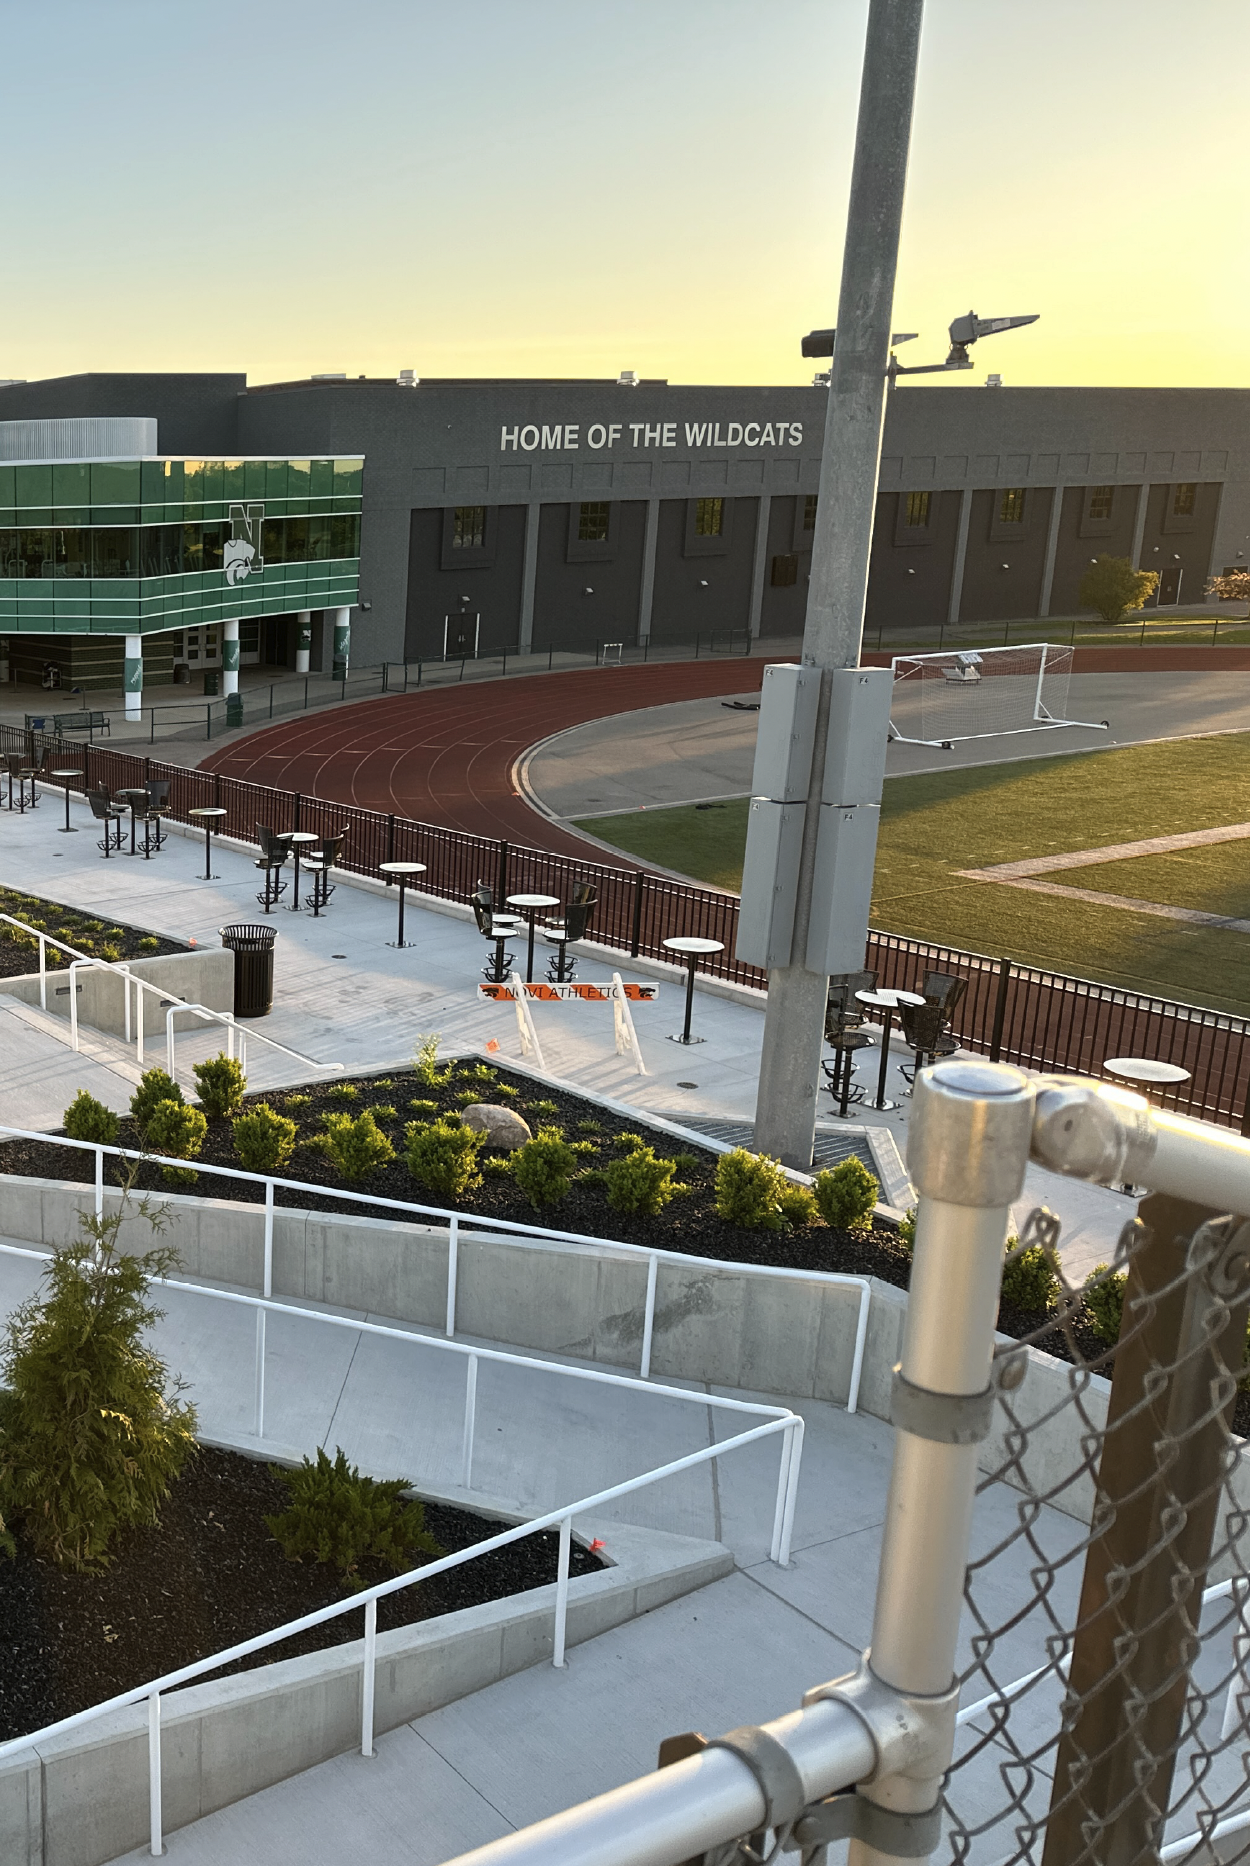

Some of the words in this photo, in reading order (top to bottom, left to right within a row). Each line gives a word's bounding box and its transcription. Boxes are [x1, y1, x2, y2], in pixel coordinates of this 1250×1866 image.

[500, 425, 579, 451] HOME
[587, 424, 623, 449] OF
[629, 423, 677, 448] THE
[684, 422, 804, 447] WILDCATS
[549, 987, 633, 998] ATHLETICS
